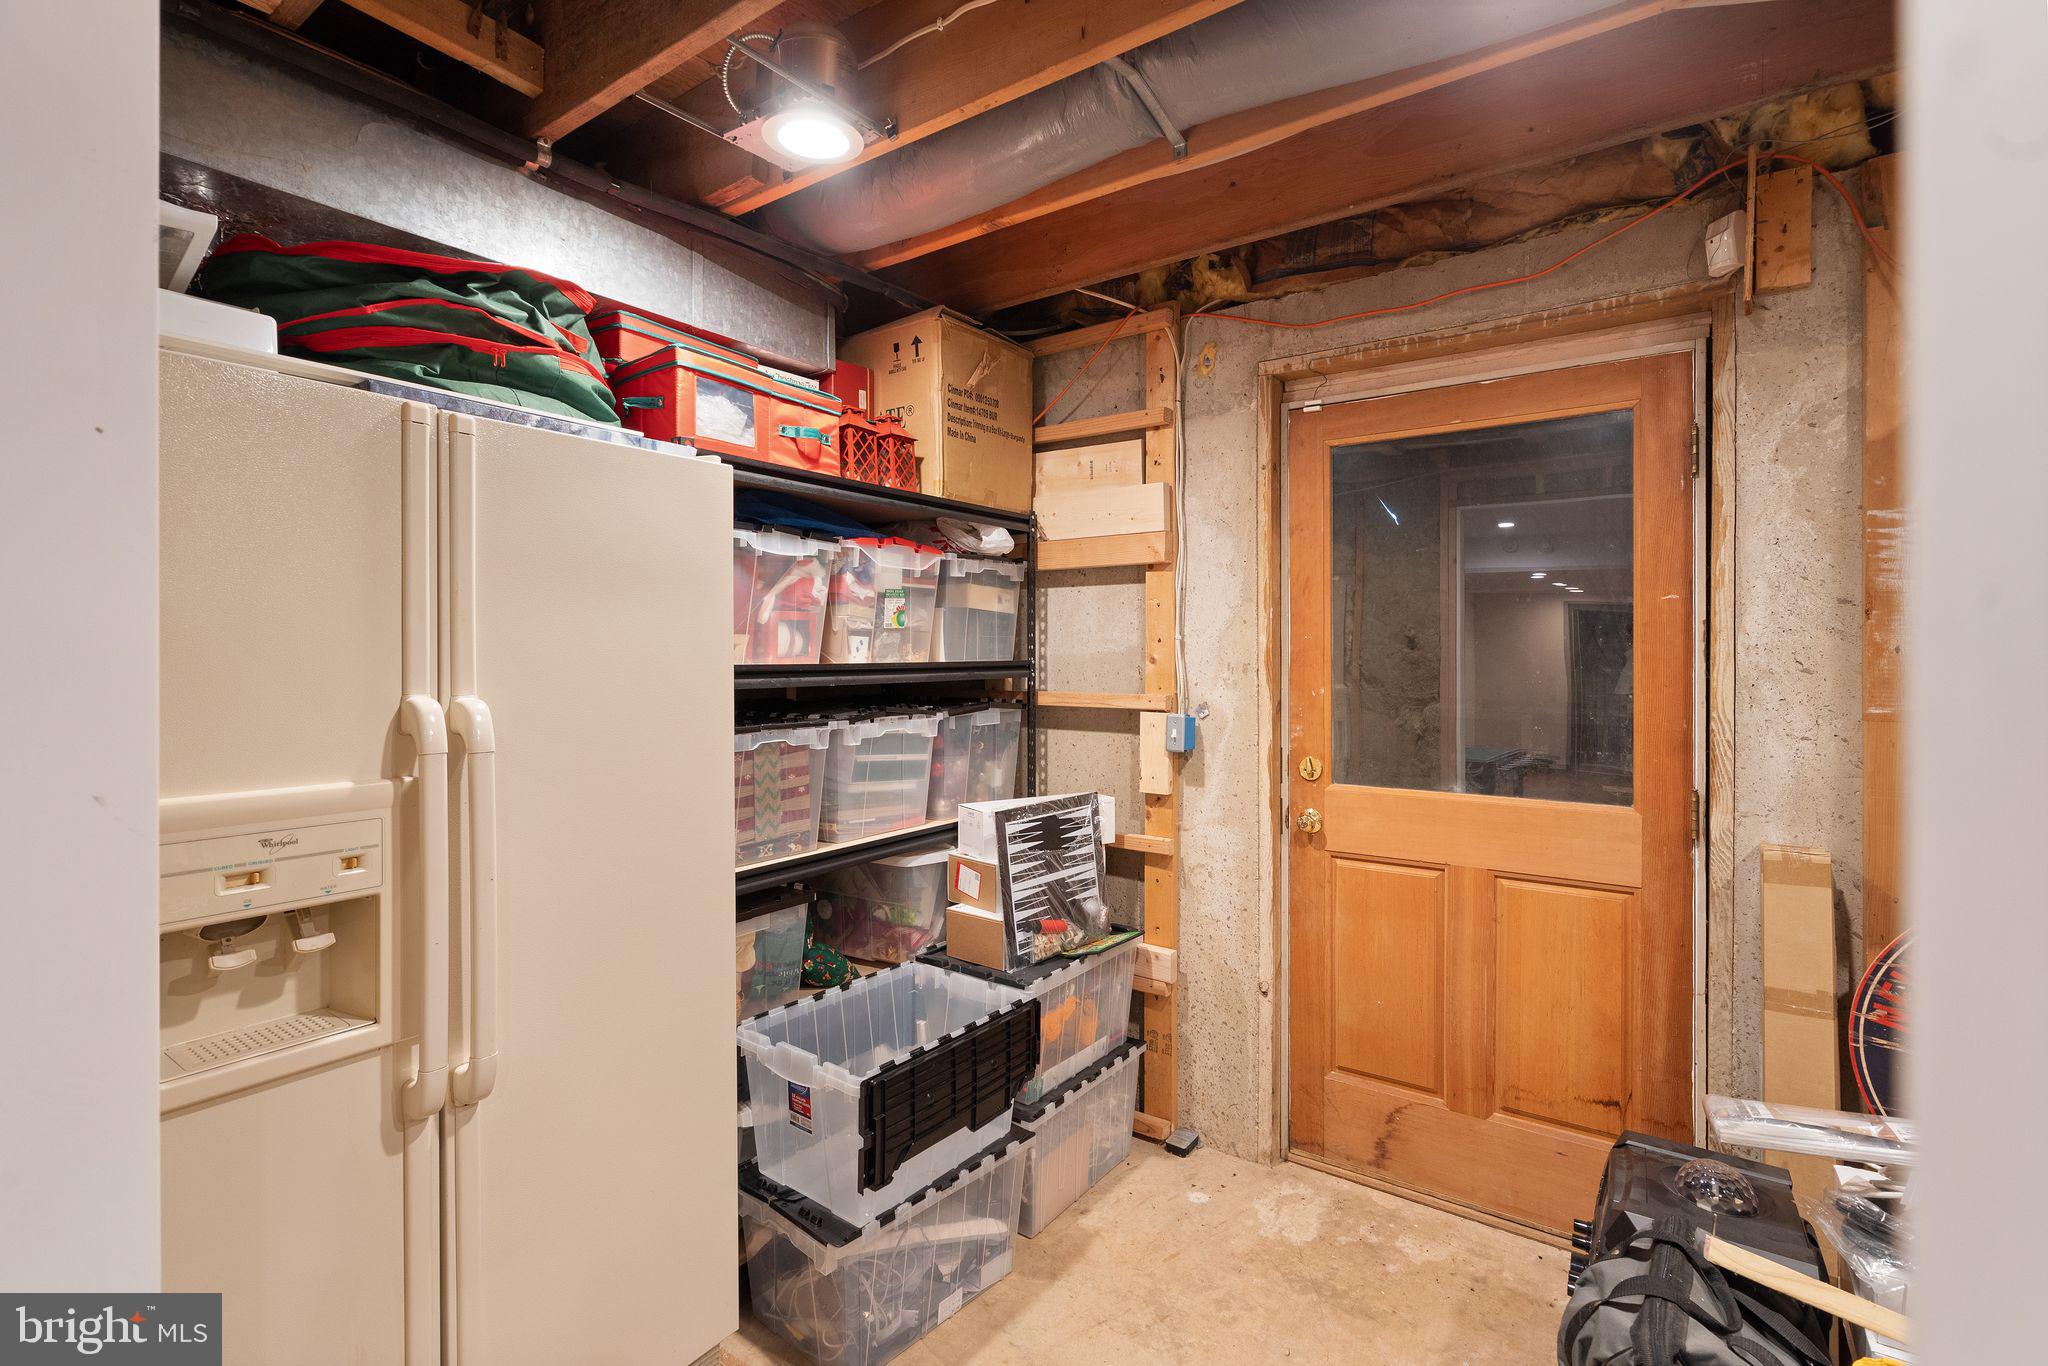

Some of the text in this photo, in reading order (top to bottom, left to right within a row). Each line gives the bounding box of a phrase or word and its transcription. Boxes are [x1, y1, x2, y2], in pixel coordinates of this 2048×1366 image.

[947, 383, 963, 397] Cinmar
[947, 398, 963, 411] Cinmar
[947, 426, 959, 439] Made
[965, 431, 977, 443] China
[259, 837, 299, 850] Whirlpool
